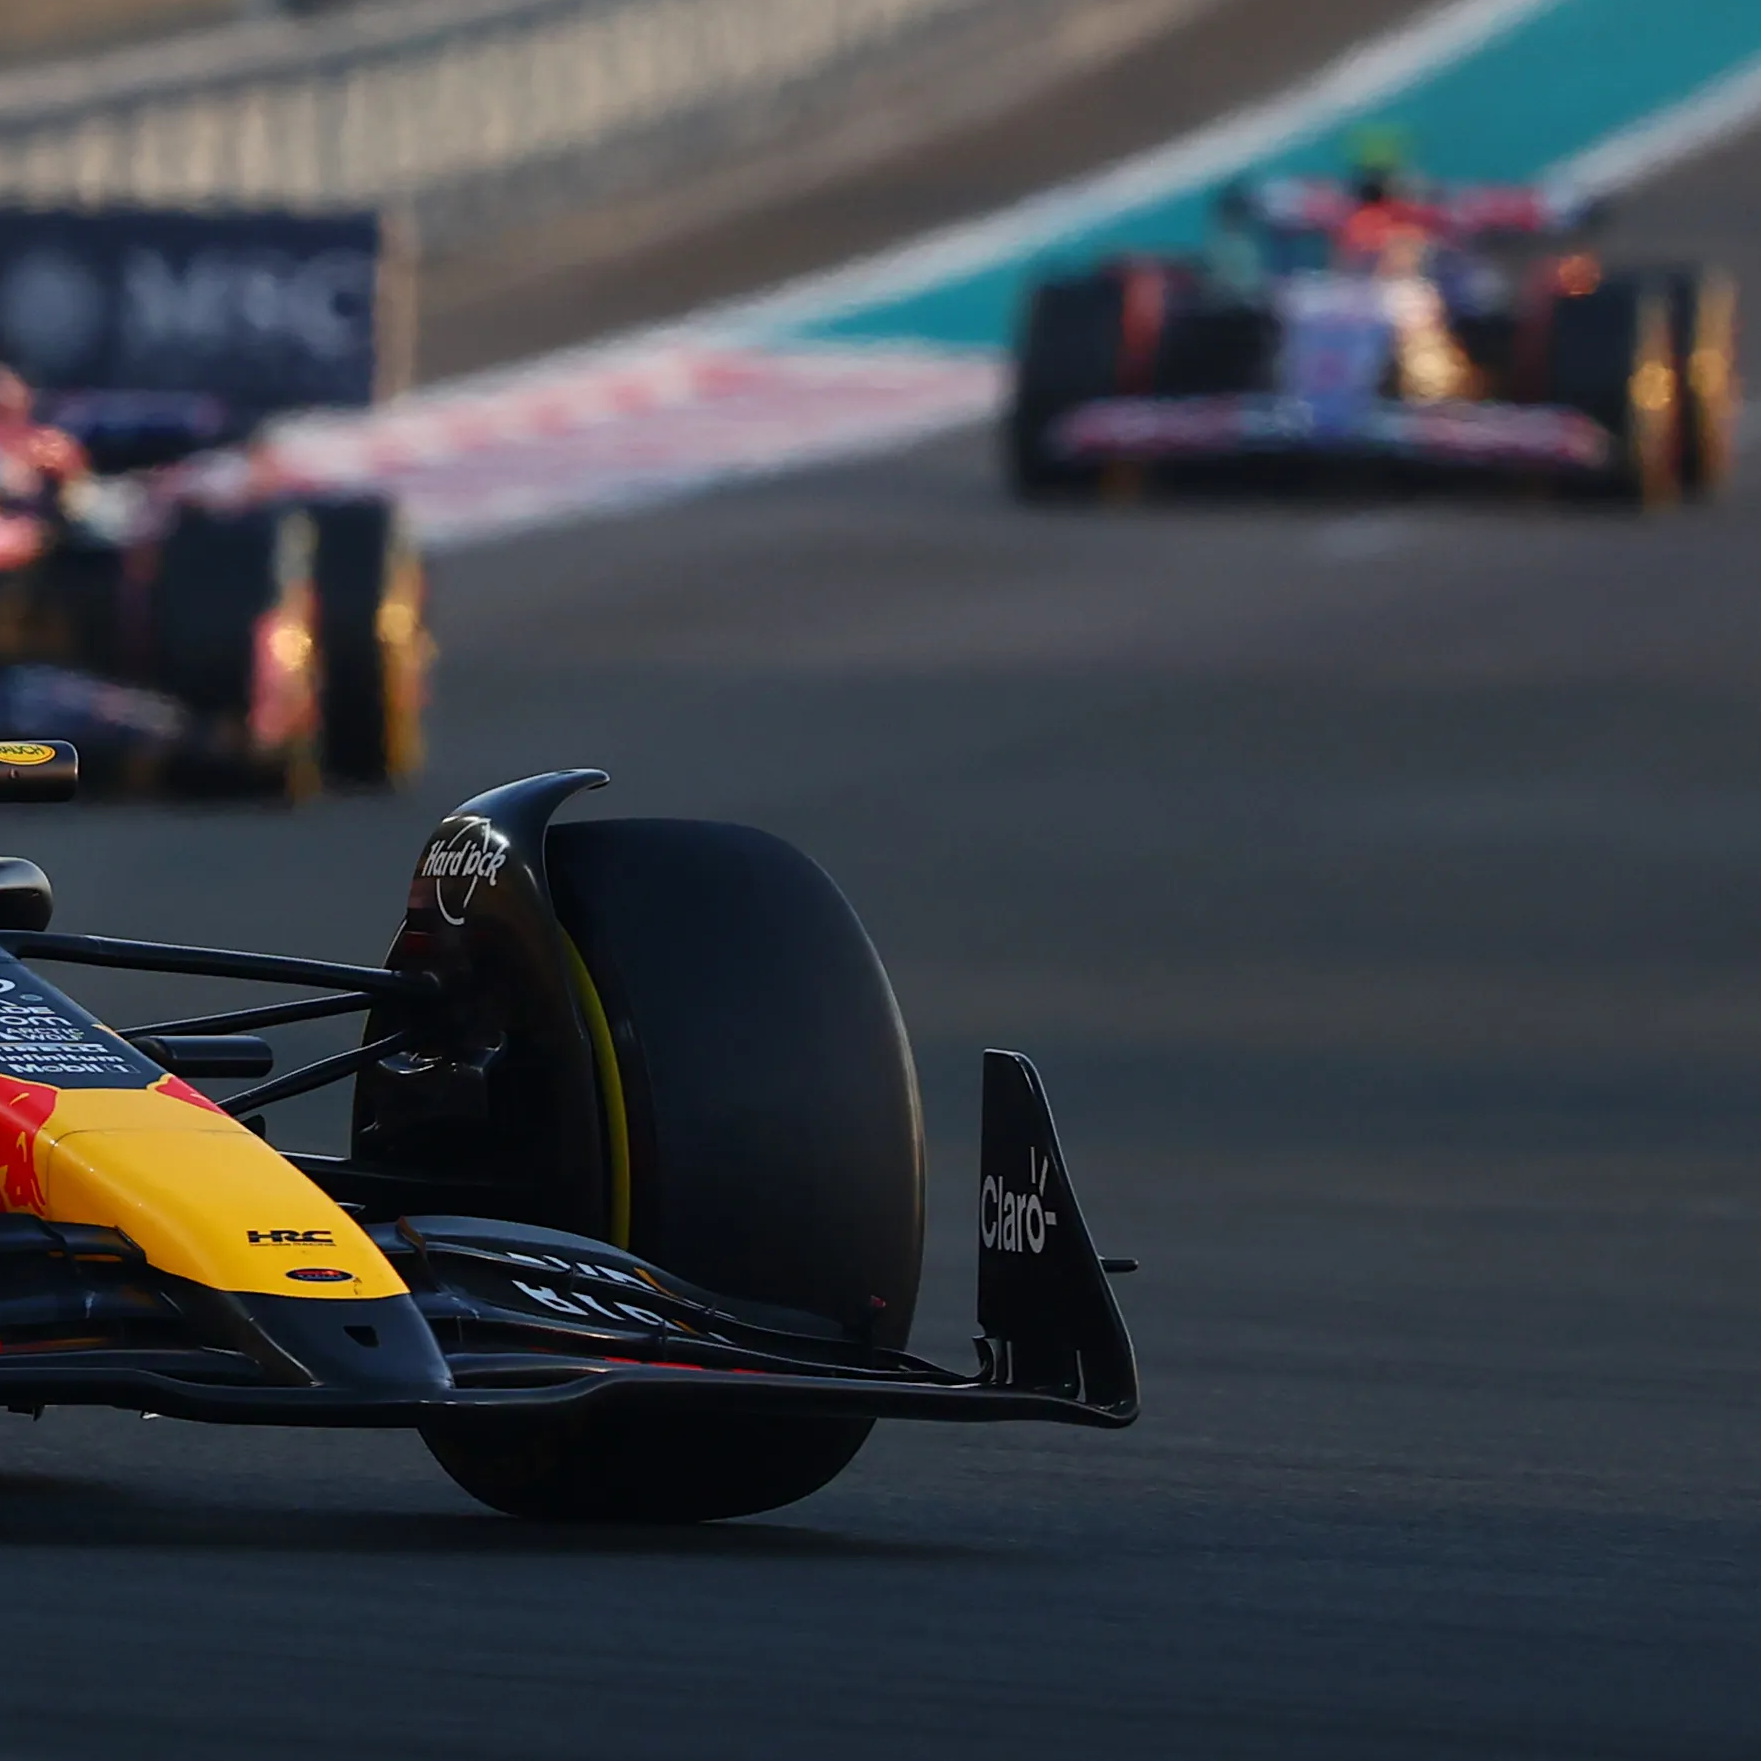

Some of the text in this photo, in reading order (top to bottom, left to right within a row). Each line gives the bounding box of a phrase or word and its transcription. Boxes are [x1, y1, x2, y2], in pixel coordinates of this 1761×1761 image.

[421, 839, 472, 877] Hard
[8, 1063, 104, 1074] Mobil
[981, 1175, 1046, 1254] Claro
[246, 1230, 334, 1243] HRC
